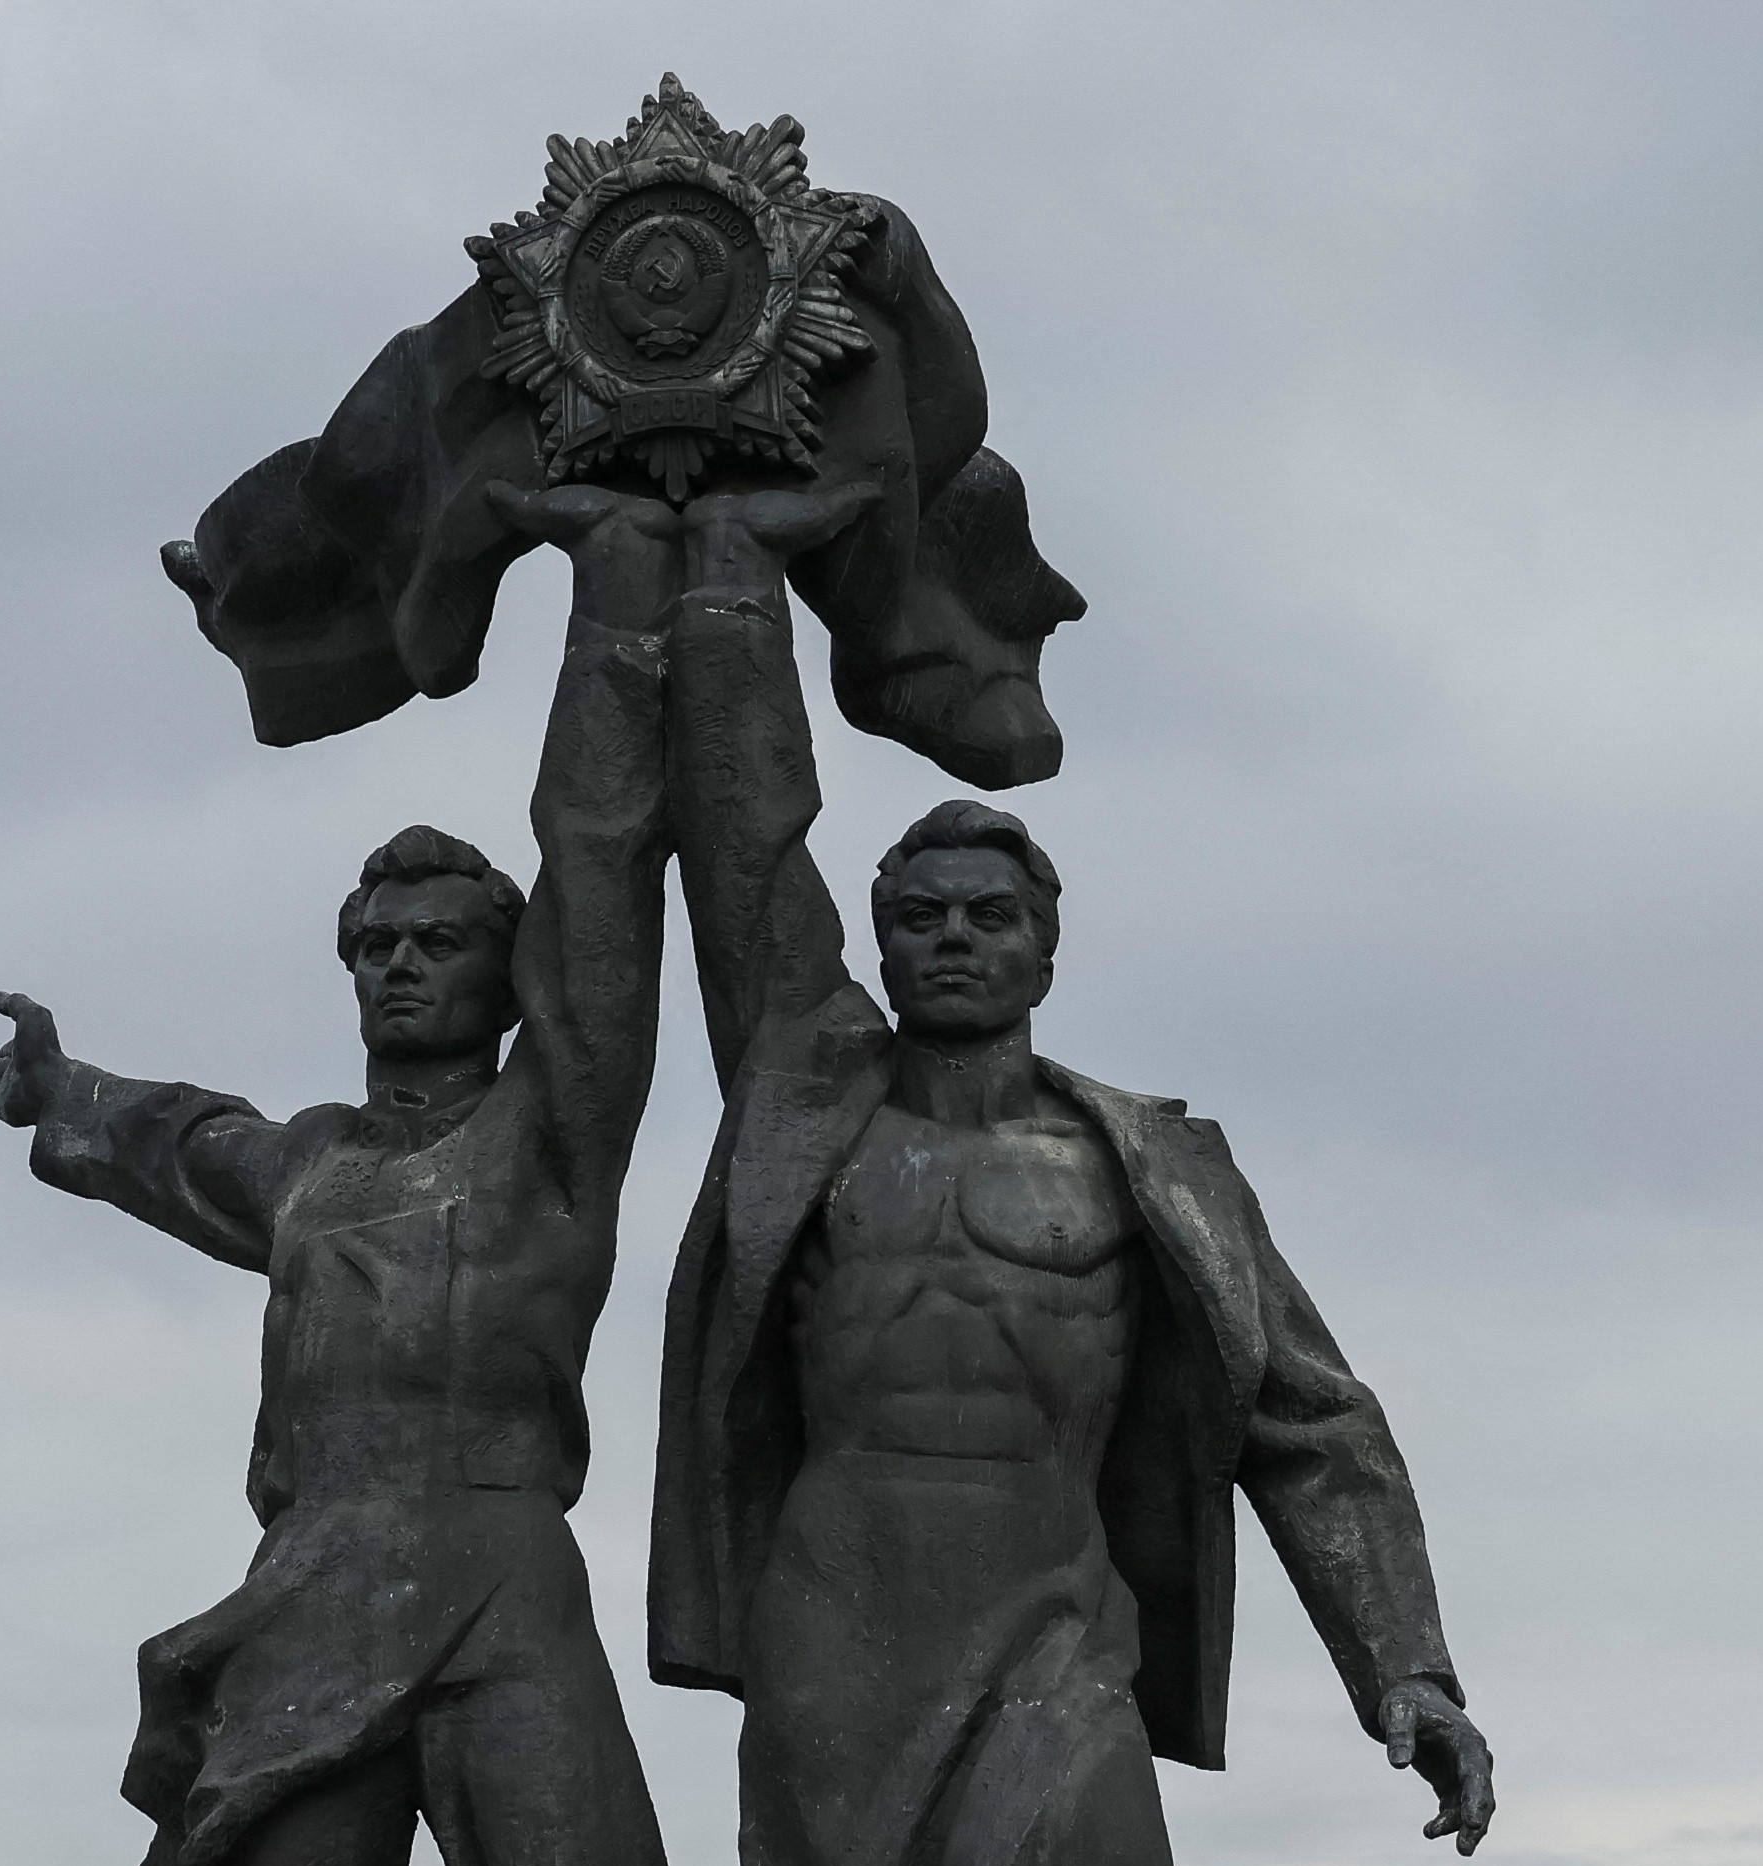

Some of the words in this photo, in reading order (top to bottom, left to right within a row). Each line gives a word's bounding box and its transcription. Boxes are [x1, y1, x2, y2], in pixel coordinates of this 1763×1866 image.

[586, 199, 655, 259] ДРУЖБА
[668, 194, 749, 248] НАРОДОВ
[628, 394, 708, 426] СССР
